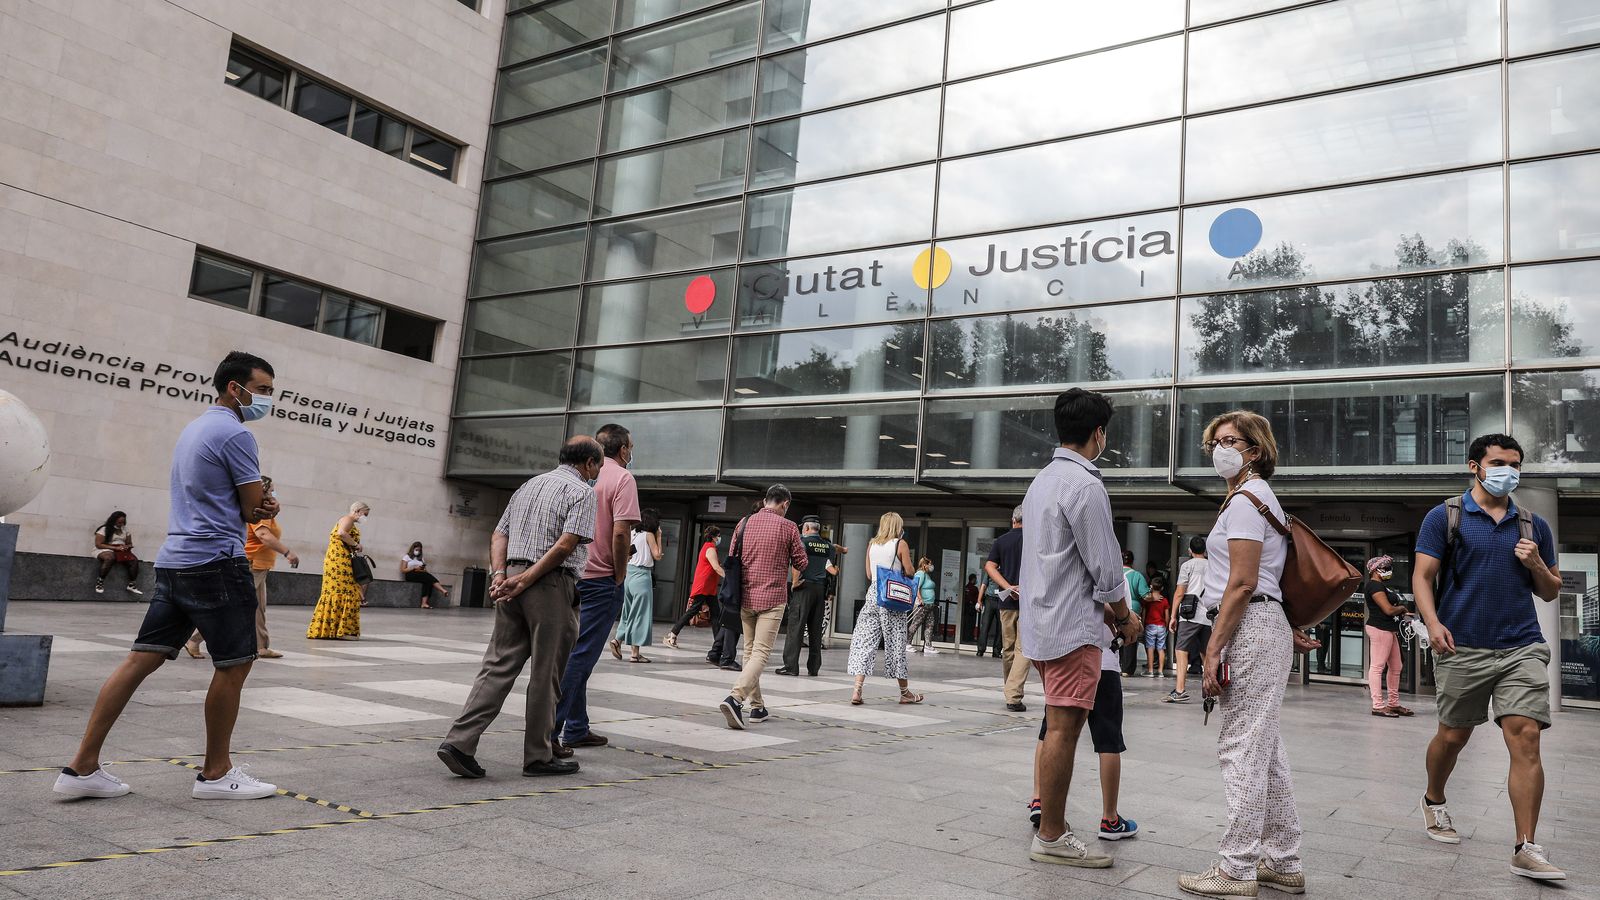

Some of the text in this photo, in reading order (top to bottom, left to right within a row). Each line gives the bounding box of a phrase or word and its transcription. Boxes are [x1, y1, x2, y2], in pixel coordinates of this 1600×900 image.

[751, 225, 1175, 299] Ciutat Justícia
[0, 331, 435, 434] Audiència Prov Fiscalia i Jutjats
[0, 350, 130, 389] Audiencia
[271, 404, 332, 428] iscalía
[338, 419, 348, 433] y
[354, 422, 436, 449] Juzgados
[808, 541, 831, 549] GUARDIA
[1319, 512, 1396, 523] Entrada Entrada
